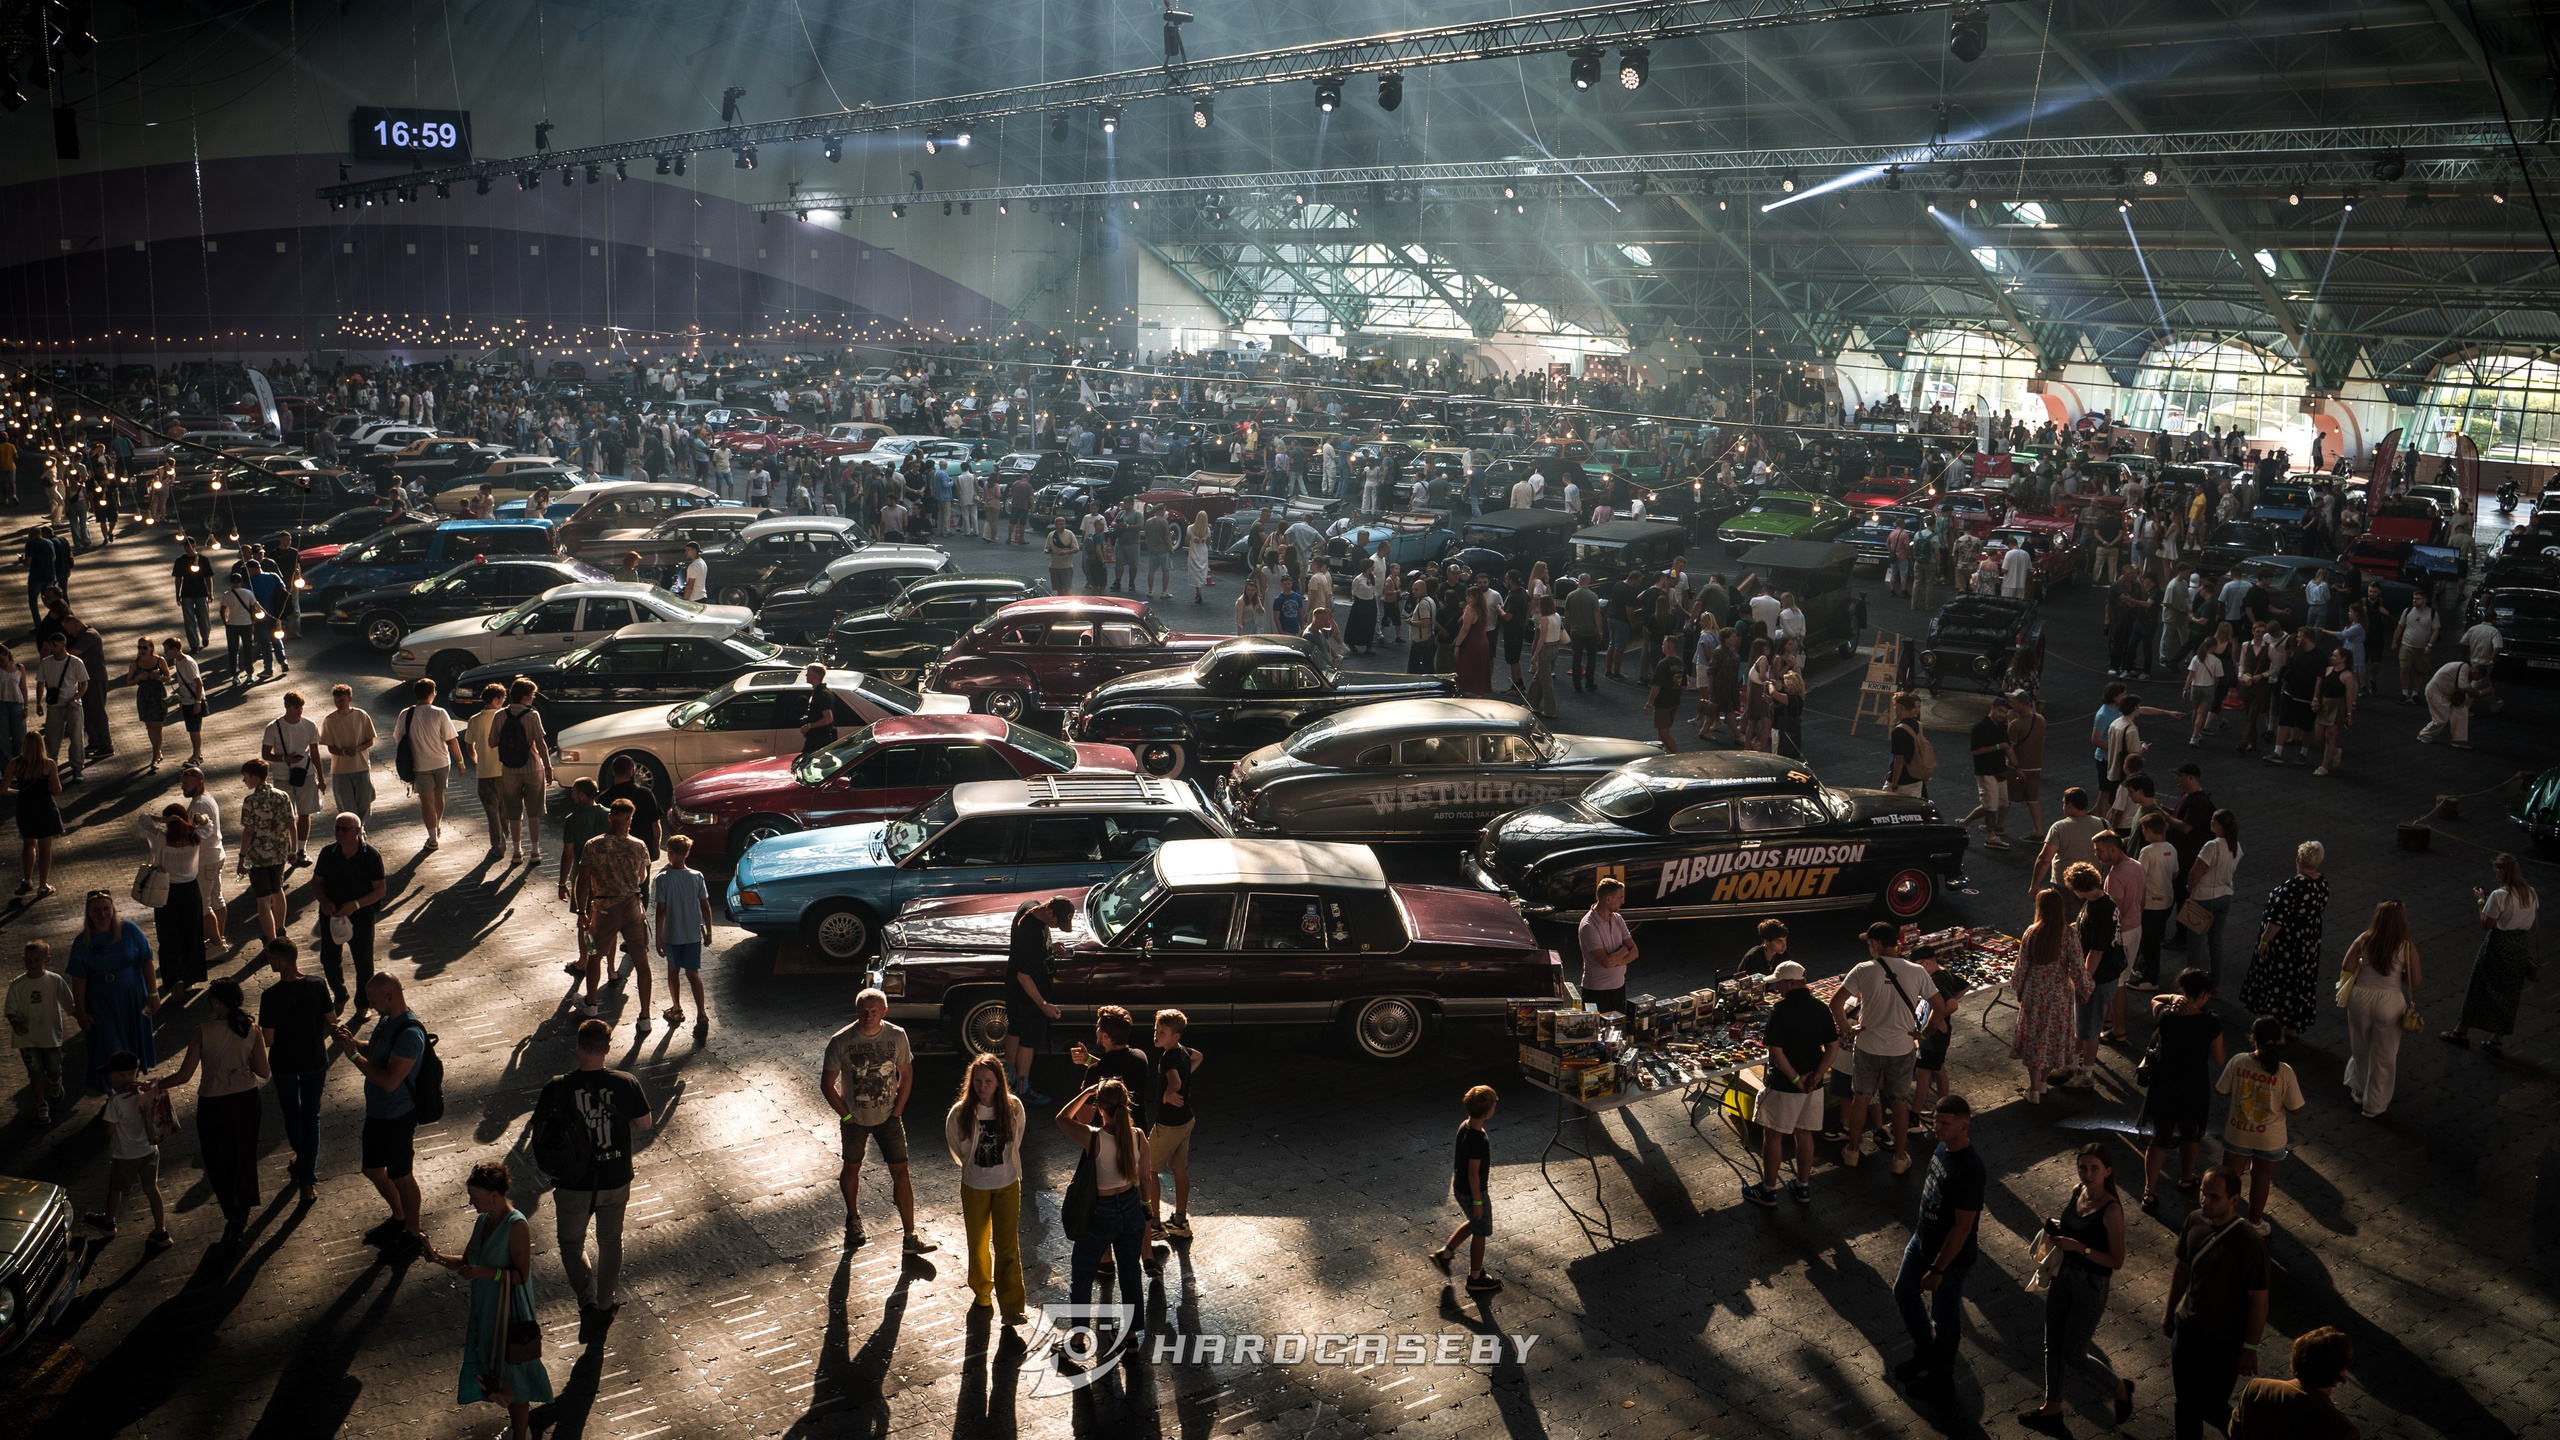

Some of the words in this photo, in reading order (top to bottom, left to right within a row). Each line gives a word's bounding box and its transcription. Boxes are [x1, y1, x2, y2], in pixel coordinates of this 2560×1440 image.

[374, 120, 457, 148] 16:59
[1867, 683, 1892, 691] KROWN
[1369, 783, 1562, 815] WESTMOTORS
[1434, 812, 1455, 820] АВТО
[1457, 811, 1474, 819] ПОД
[1475, 810, 1500, 819] ЗАКАЗ
[1870, 816, 1890, 824] TWIN
[1656, 849, 1782, 900] FABULOUS
[1783, 844, 1866, 867] HUDSON
[1711, 867, 1841, 902] HORNET
[848, 1042, 881, 1053] RUMBLE
[887, 1041, 896, 1050] IN
[2236, 1067, 2277, 1086] LIMON
[855, 1100, 868, 1109] THE
[2230, 1117, 2266, 1133] CELLO
